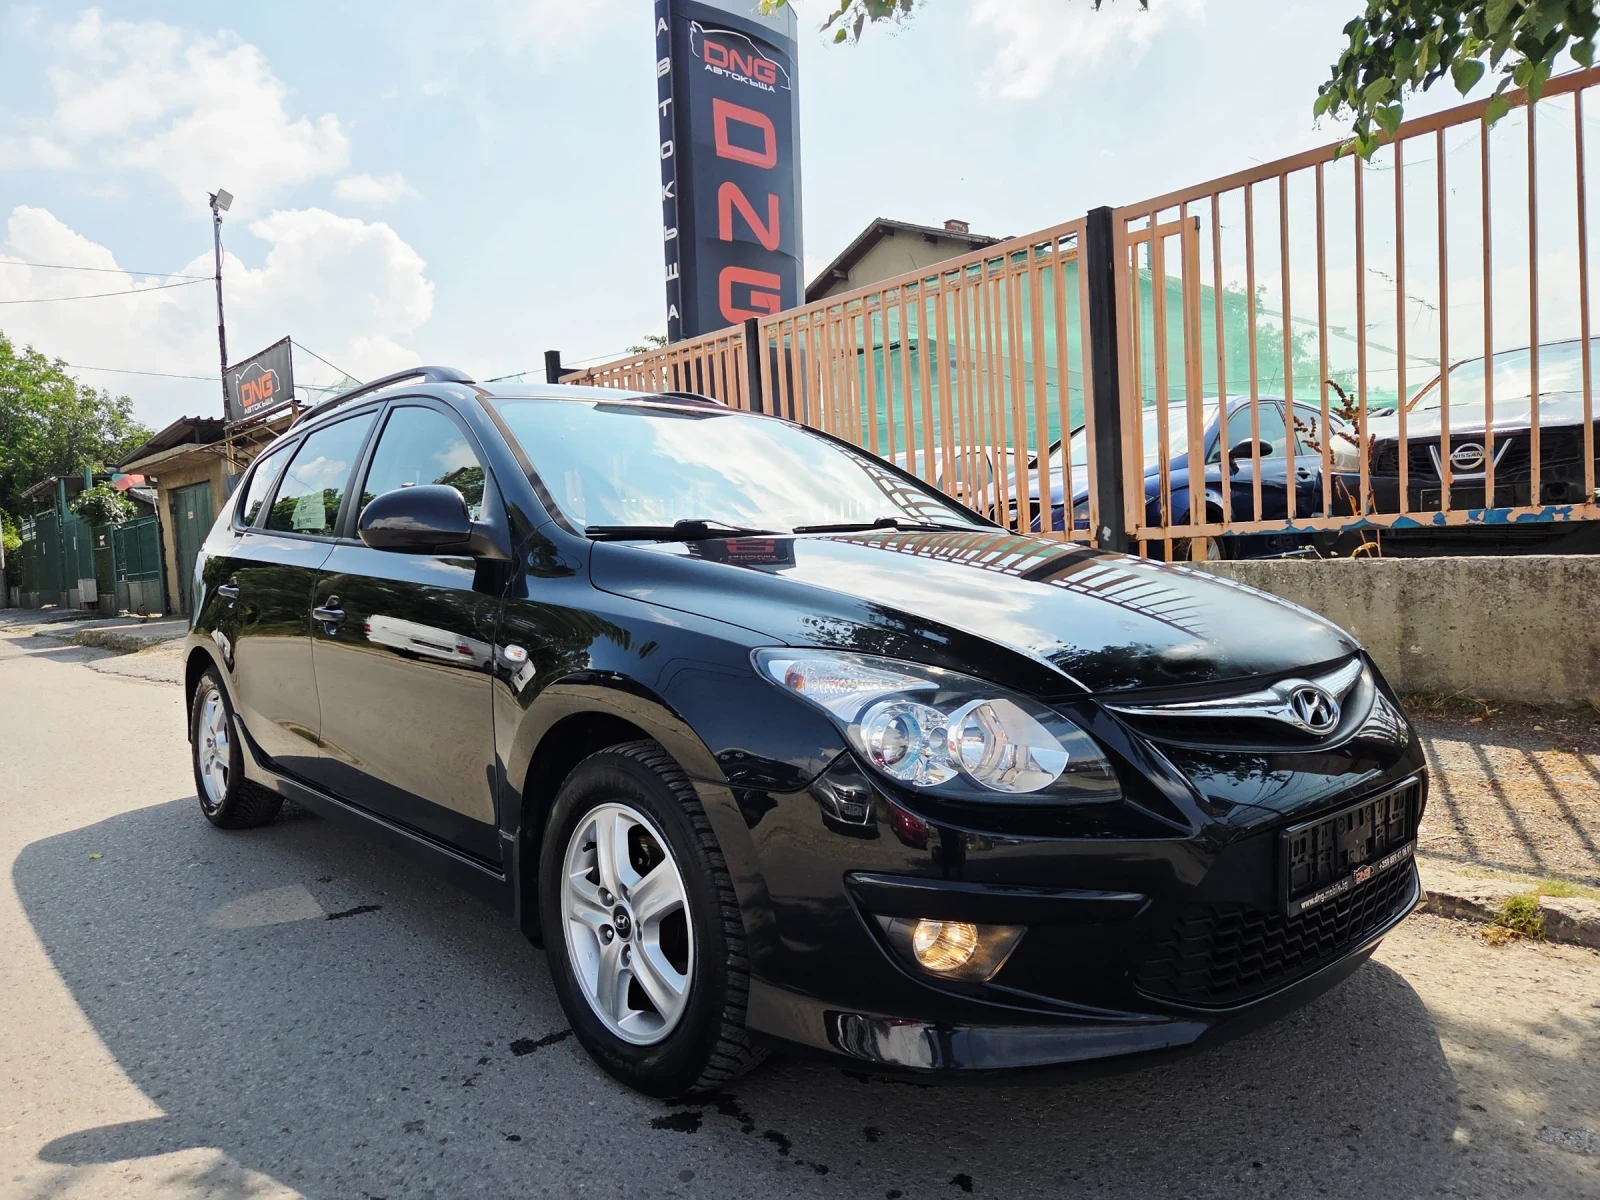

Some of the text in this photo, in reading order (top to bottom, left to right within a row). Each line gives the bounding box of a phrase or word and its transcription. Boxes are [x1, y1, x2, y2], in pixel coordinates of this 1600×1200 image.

[703, 39, 777, 85] DNG
[704, 64, 776, 93] АВТОКЪЩА
[712, 97, 781, 325] DNG
[241, 371, 273, 407] DNG
[1452, 451, 1483, 459] NISSAN
